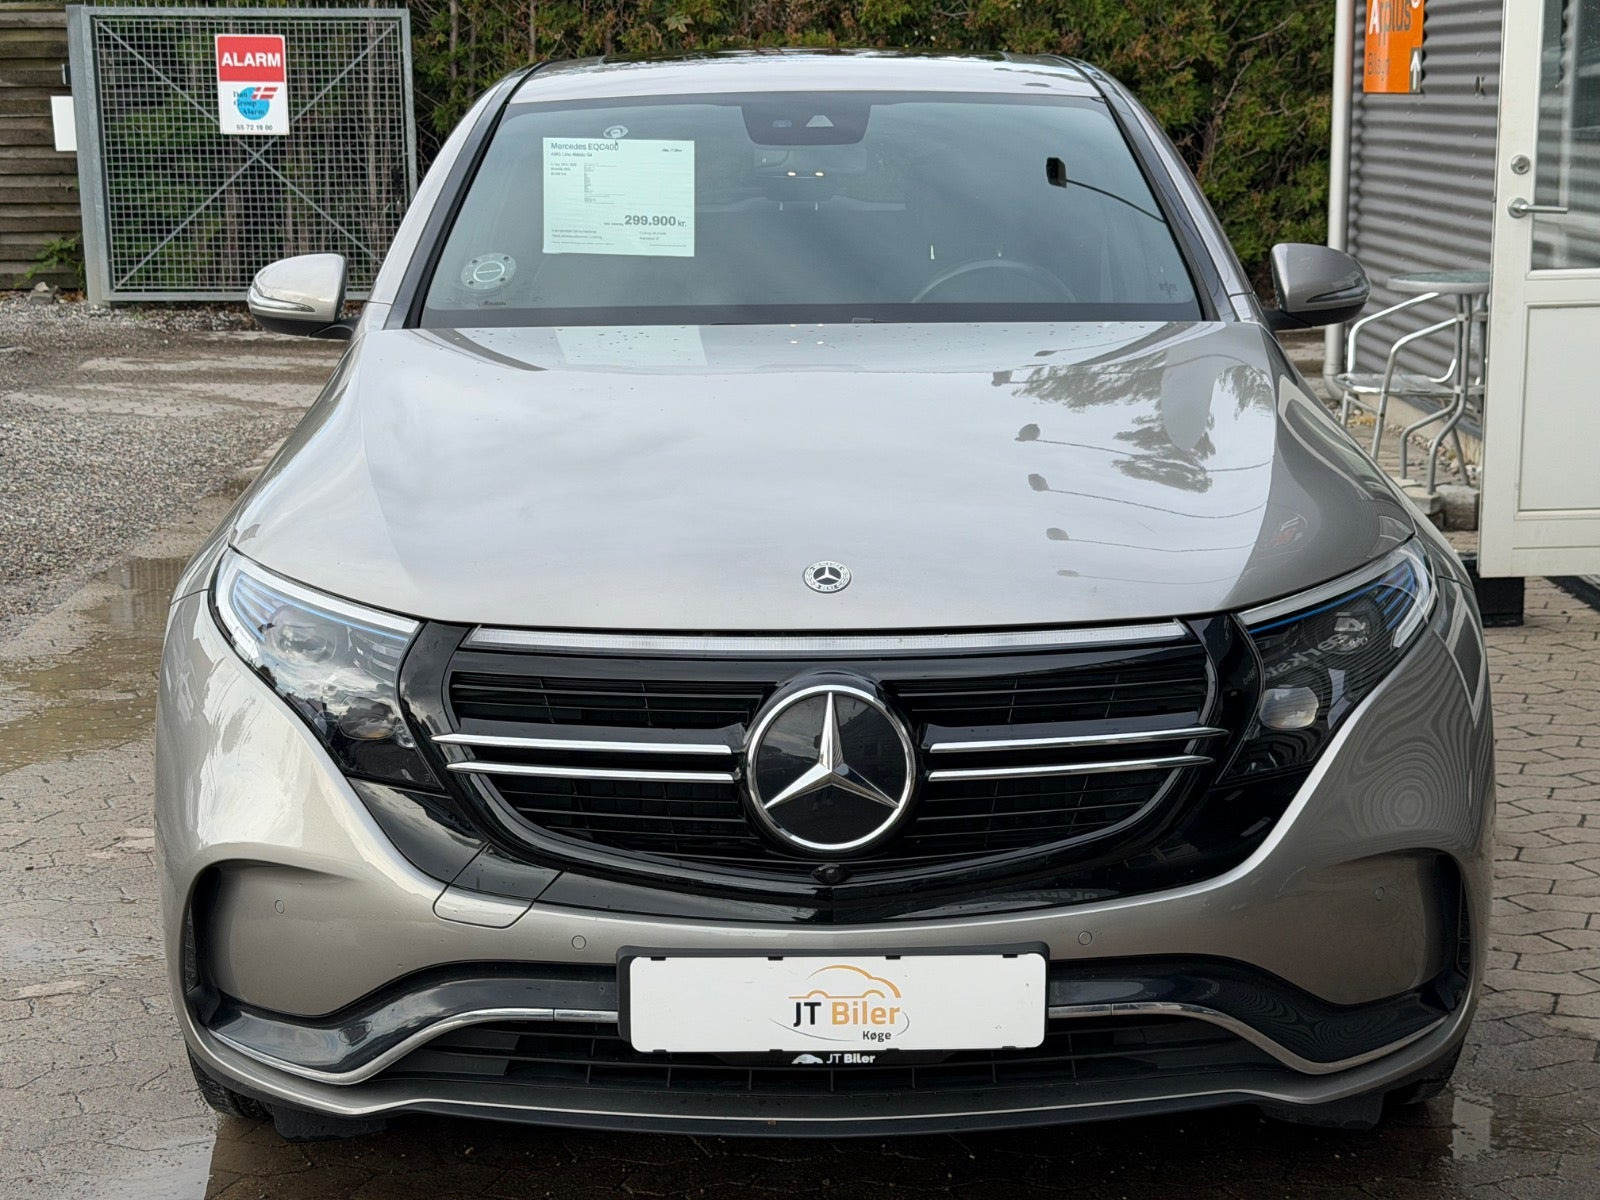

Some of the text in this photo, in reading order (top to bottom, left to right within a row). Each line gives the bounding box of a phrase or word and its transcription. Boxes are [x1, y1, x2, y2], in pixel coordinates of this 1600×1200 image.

[221, 52, 281, 67] ALARM
[233, 100, 257, 109] Group
[551, 142, 619, 151] Mercedes EQC400
[624, 215, 676, 226] 299.900
[792, 1001, 901, 1028] JT Biler
[862, 1029, 892, 1042] Køge
[826, 1052, 875, 1064] JT Biler
